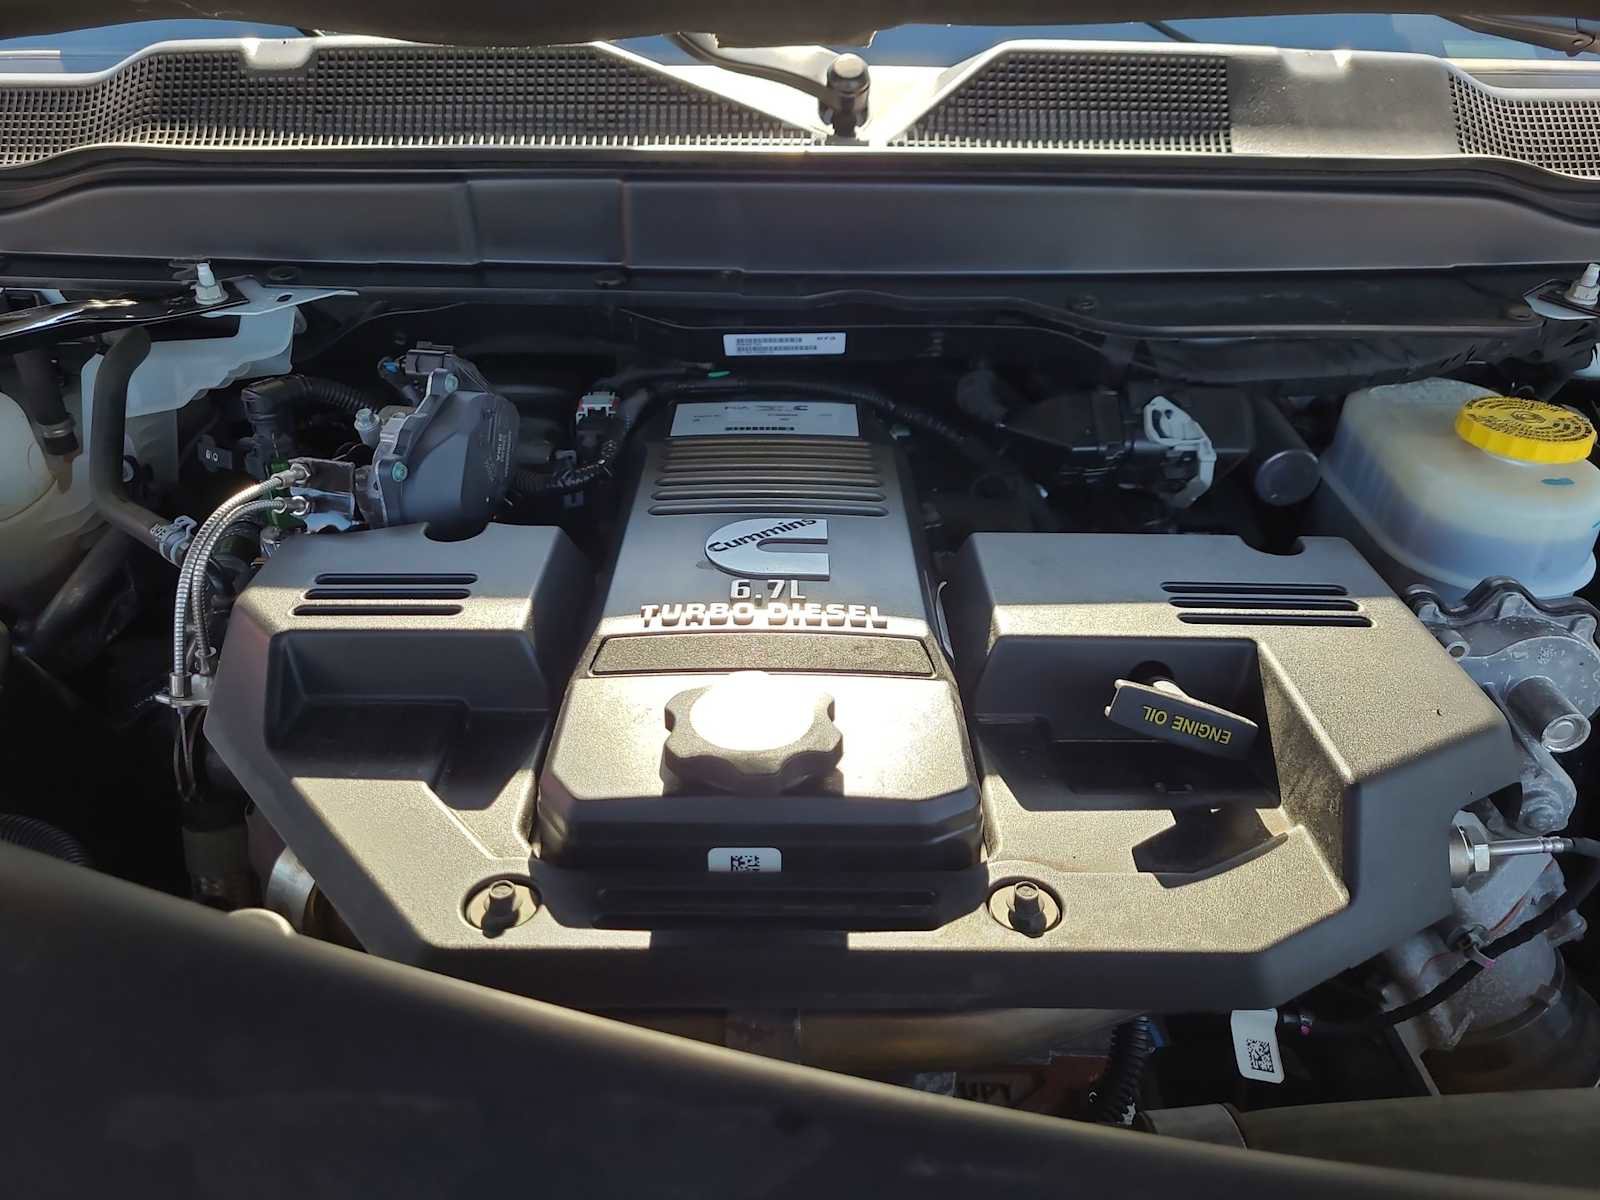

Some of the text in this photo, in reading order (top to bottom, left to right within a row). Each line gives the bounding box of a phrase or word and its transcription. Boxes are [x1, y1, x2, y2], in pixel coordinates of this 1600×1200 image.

[707, 518, 817, 553] Cummins
[730, 579, 807, 601] 6.7L
[640, 602, 888, 628] TURBO DIESEL
[1142, 705, 1232, 745] ENGINE OIL
